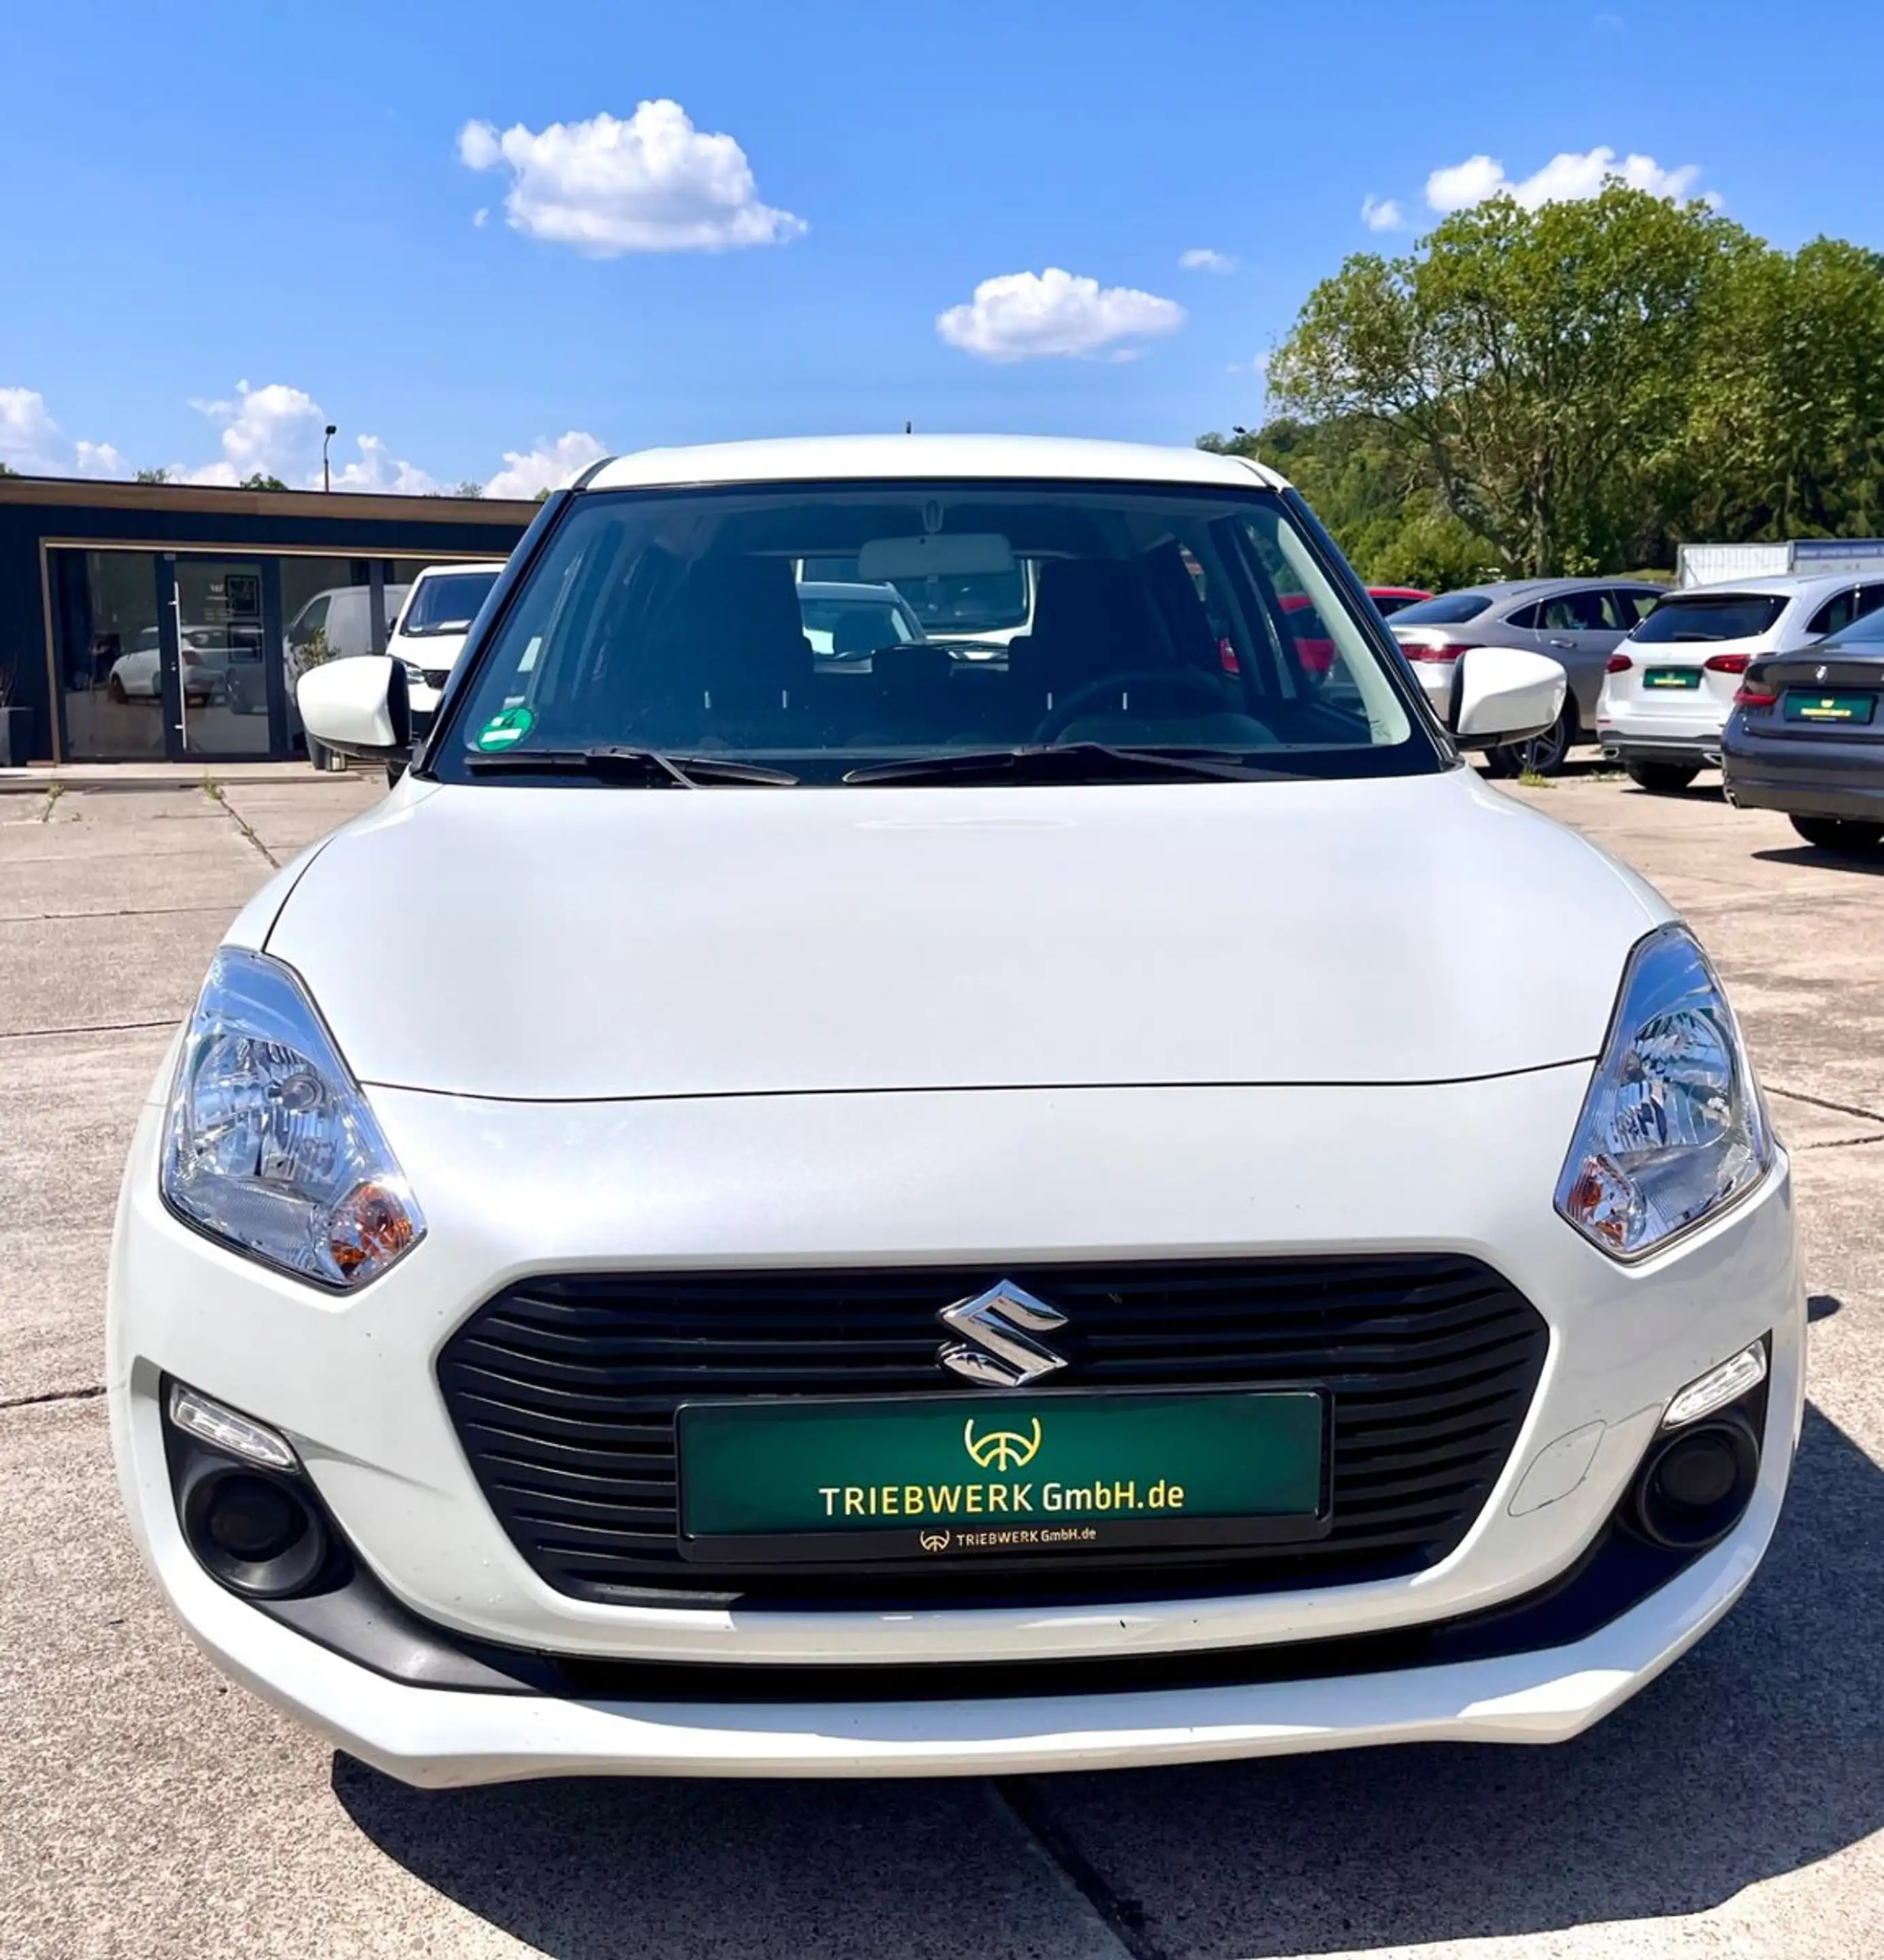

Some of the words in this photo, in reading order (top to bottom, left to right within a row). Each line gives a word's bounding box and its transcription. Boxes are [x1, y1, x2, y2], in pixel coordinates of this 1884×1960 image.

[819, 1482, 1034, 1517] TRIEBWERK
[1042, 1479, 1185, 1512] GmbH.de
[956, 1529, 1040, 1547] TRIEBWERK
[1041, 1526, 1097, 1543] GmbH.de
